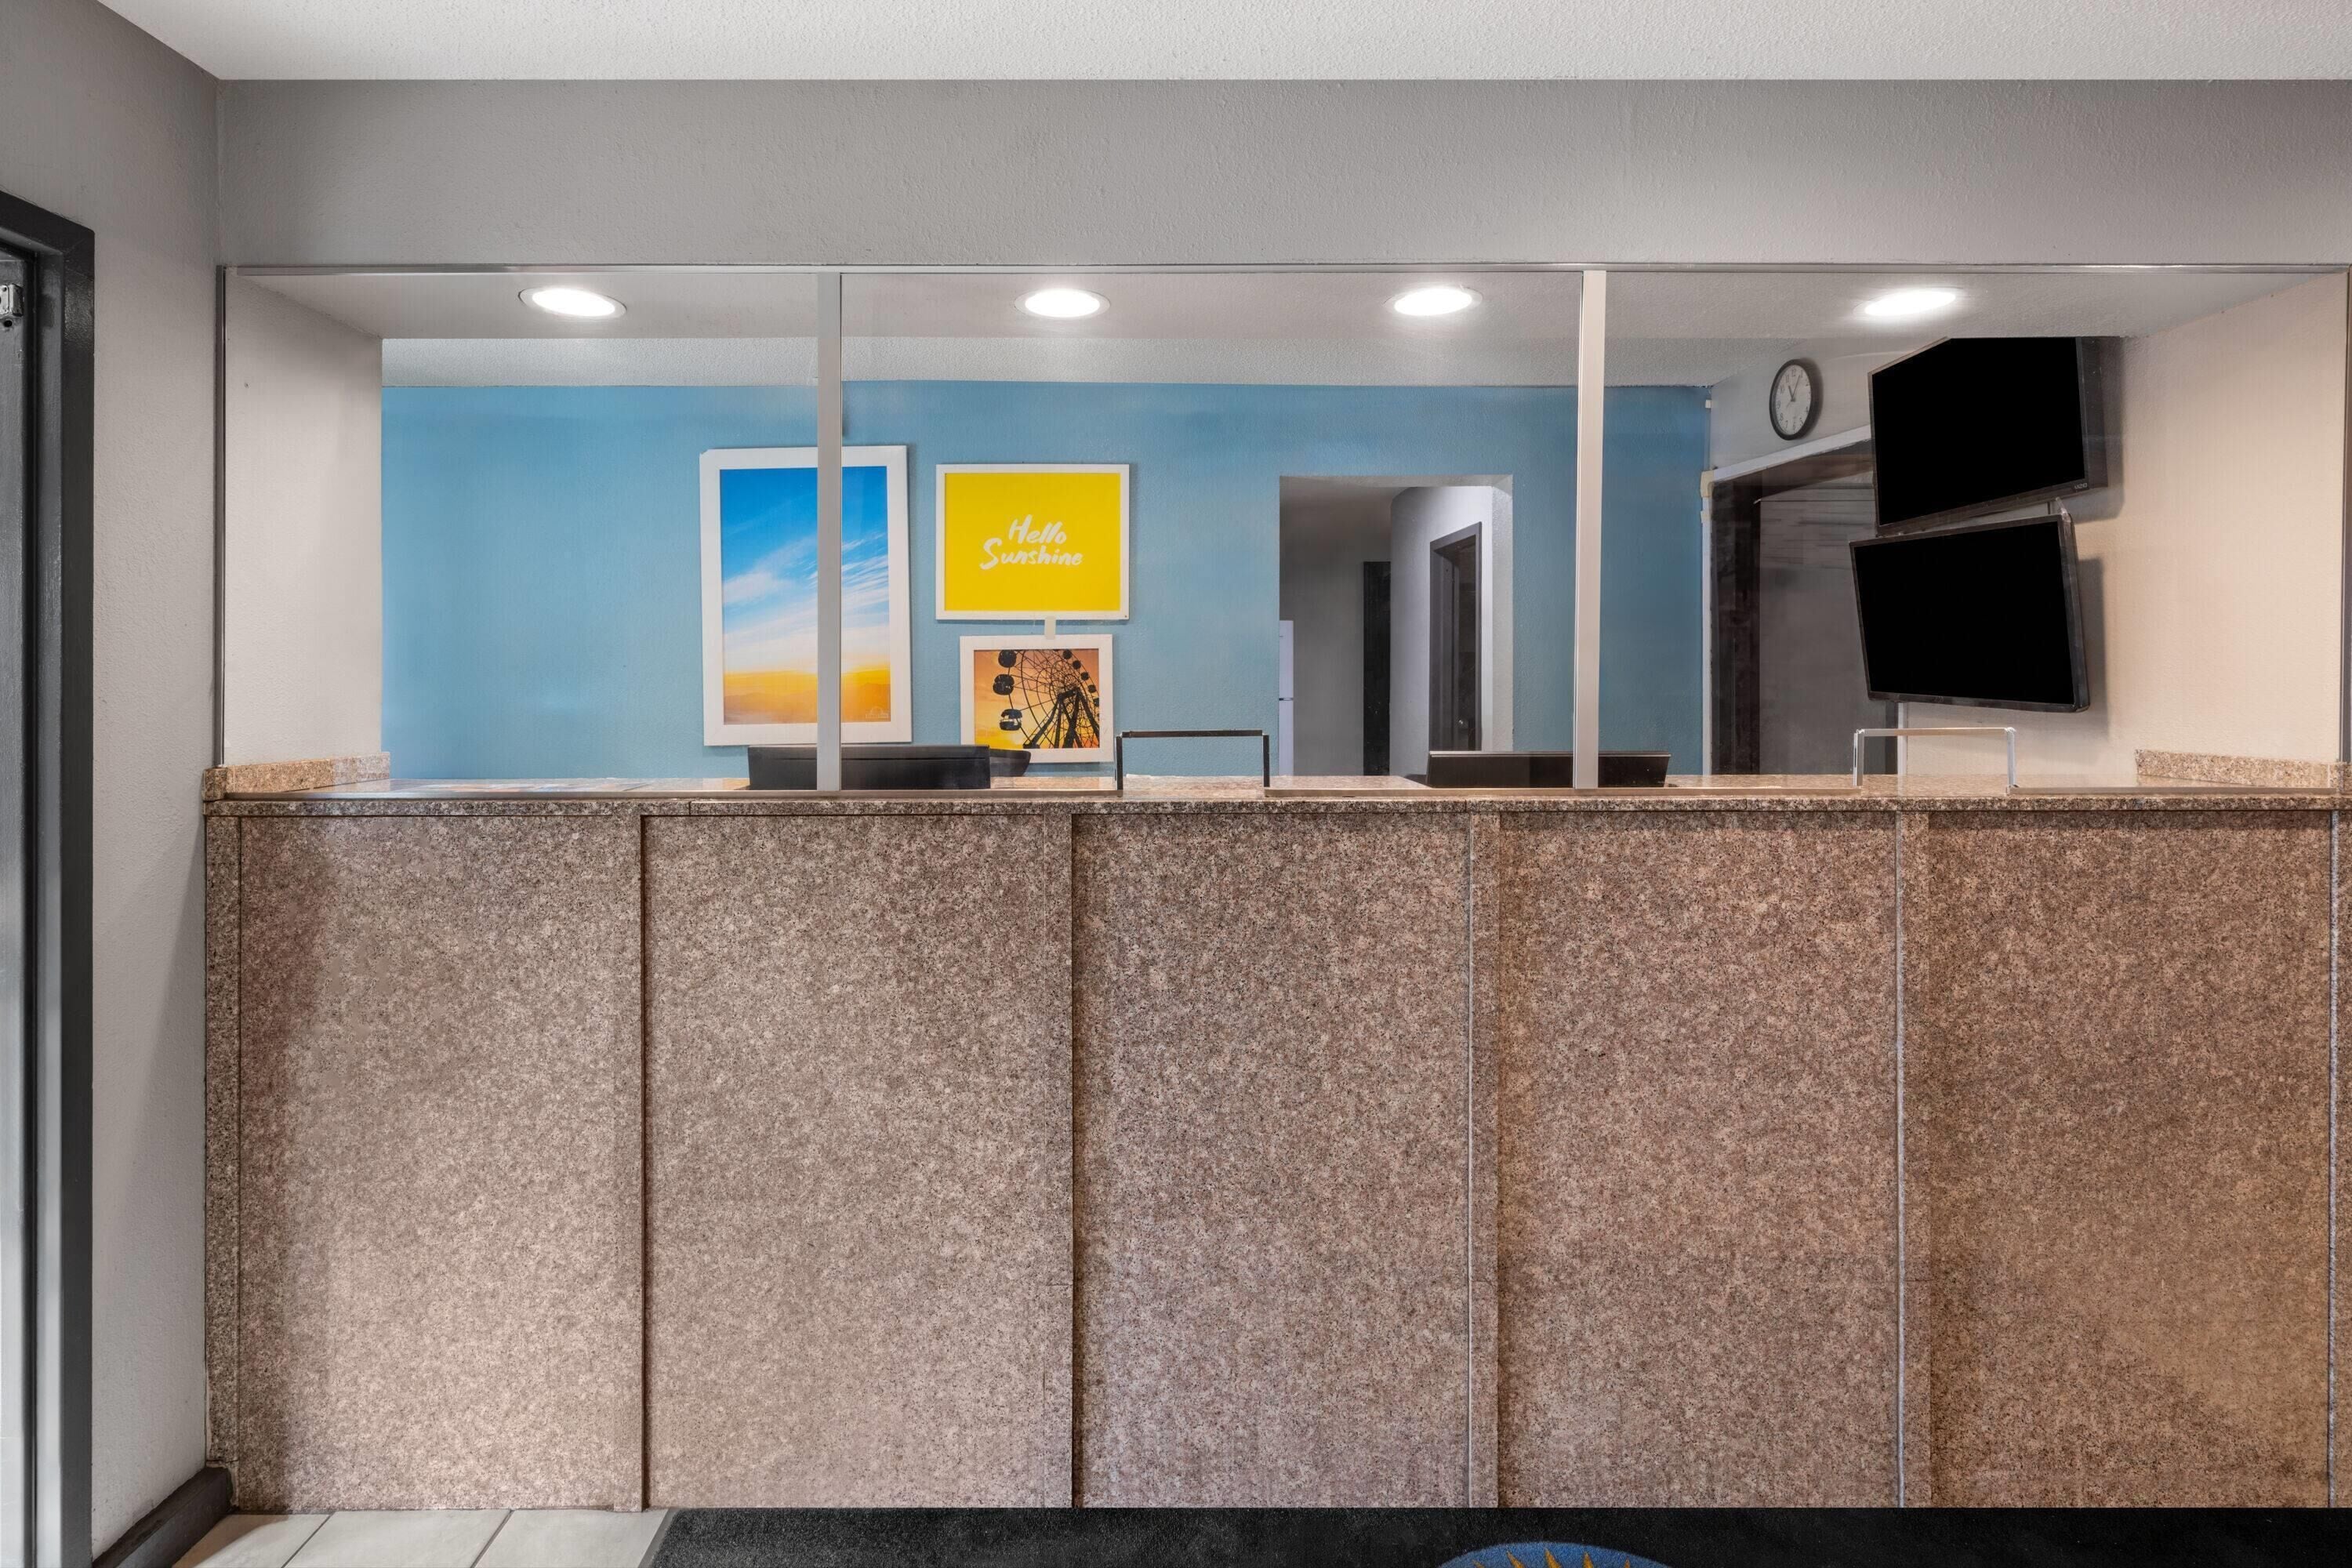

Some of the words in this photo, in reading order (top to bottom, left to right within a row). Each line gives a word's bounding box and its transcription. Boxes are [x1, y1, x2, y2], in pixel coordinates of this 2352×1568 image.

[1780, 385, 1785, 394] 10
[1008, 514, 1067, 545] Hello
[979, 538, 1083, 570] Sunshine
